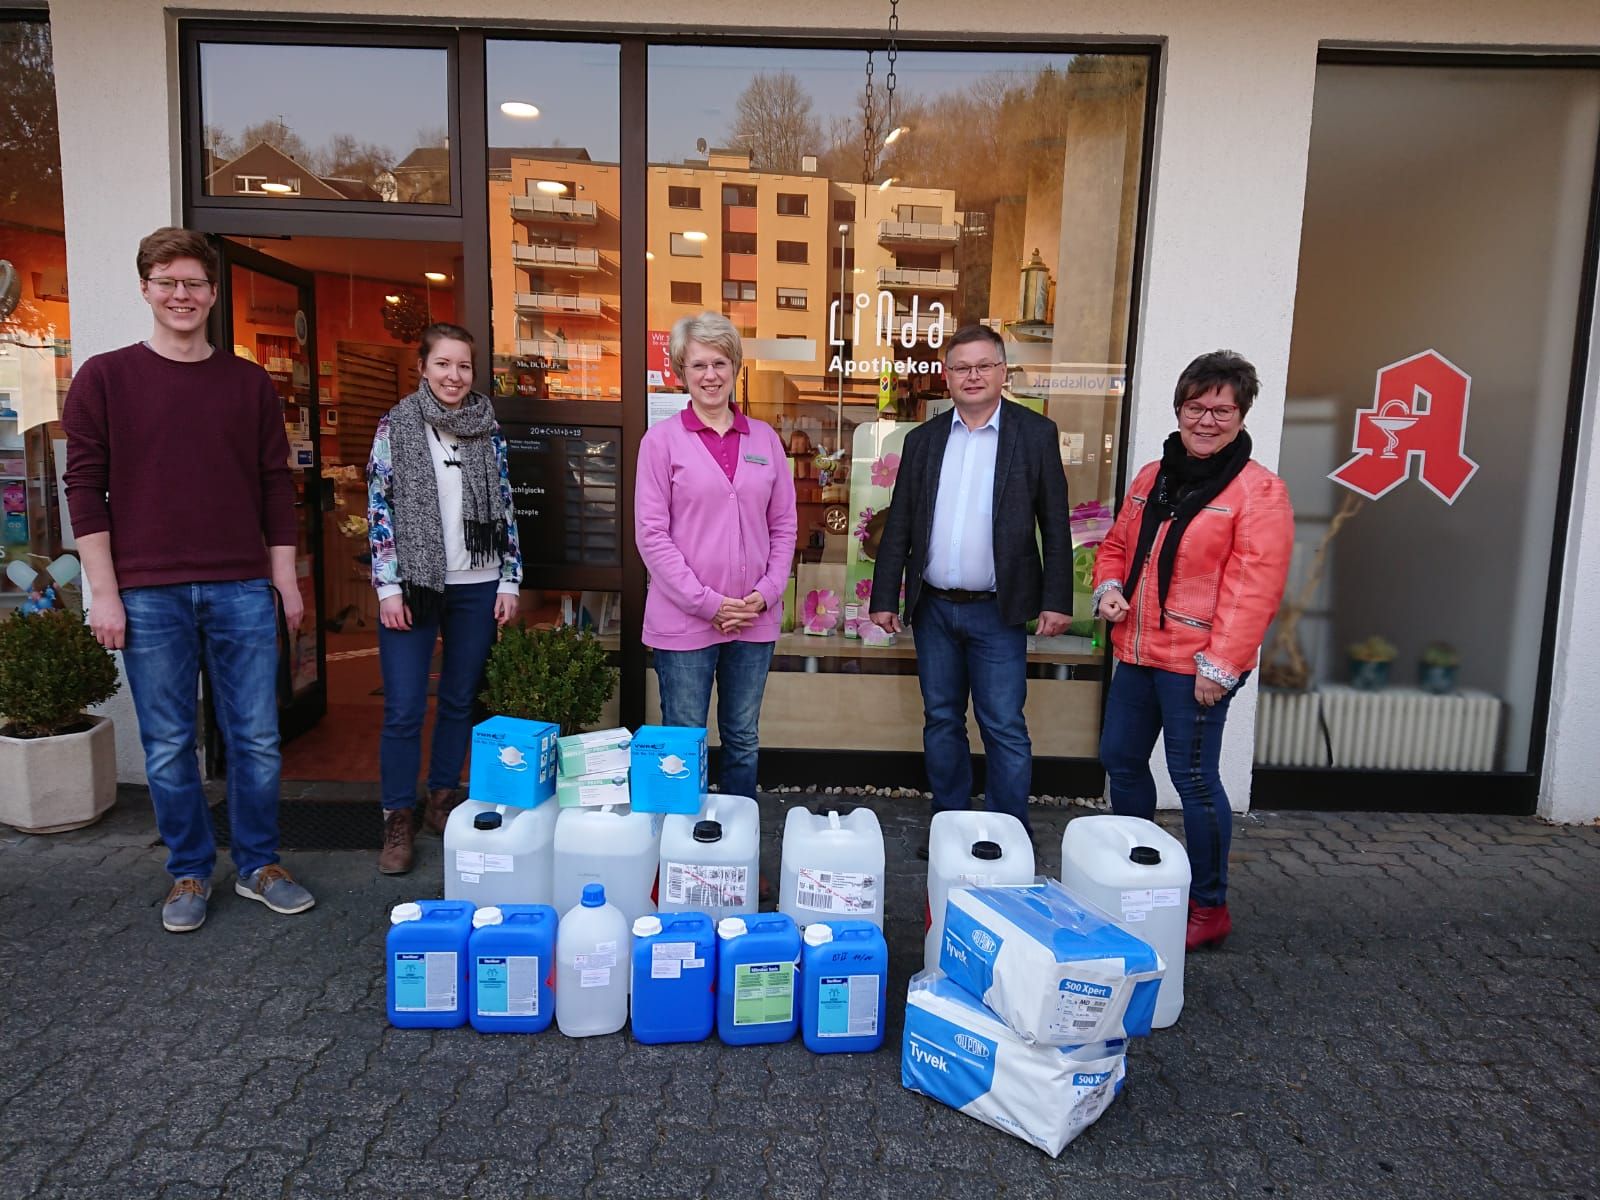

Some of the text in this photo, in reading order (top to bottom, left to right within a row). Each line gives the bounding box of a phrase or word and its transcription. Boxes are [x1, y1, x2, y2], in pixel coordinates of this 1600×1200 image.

[828, 355, 943, 376] Apotheken
[946, 936, 968, 967] Tyvek
[1065, 981, 1106, 996] 500 Xpert
[910, 1040, 947, 1072] Tyvek
[1079, 1075, 1093, 1084] 500
